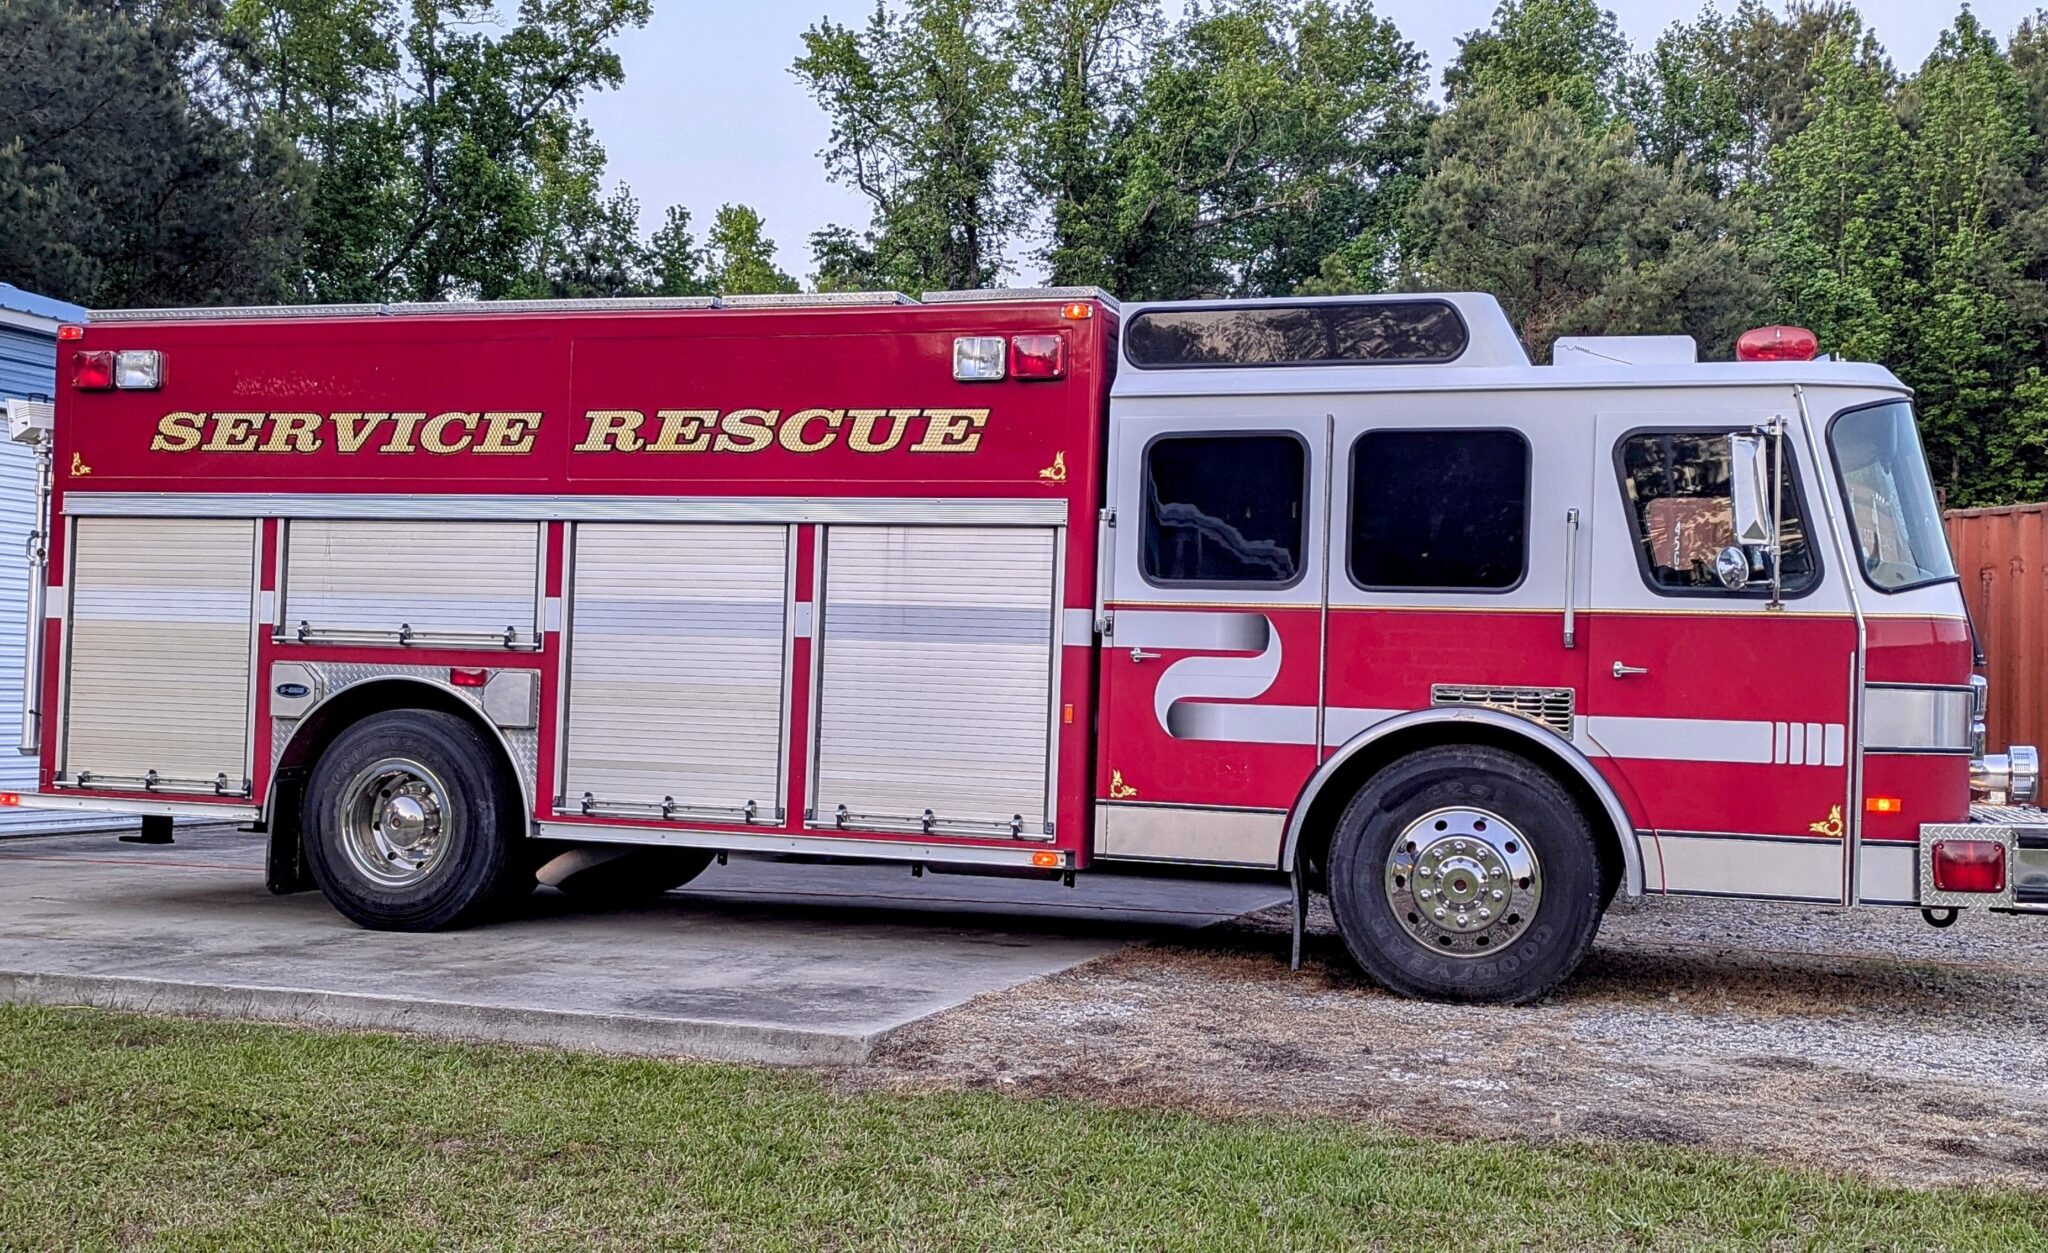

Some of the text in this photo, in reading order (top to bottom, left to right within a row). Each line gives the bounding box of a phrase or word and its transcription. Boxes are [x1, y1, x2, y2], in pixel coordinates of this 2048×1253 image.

[149, 407, 991, 455] SERVICE RESCUE
[1372, 916, 1553, 979] GOODYEAR
